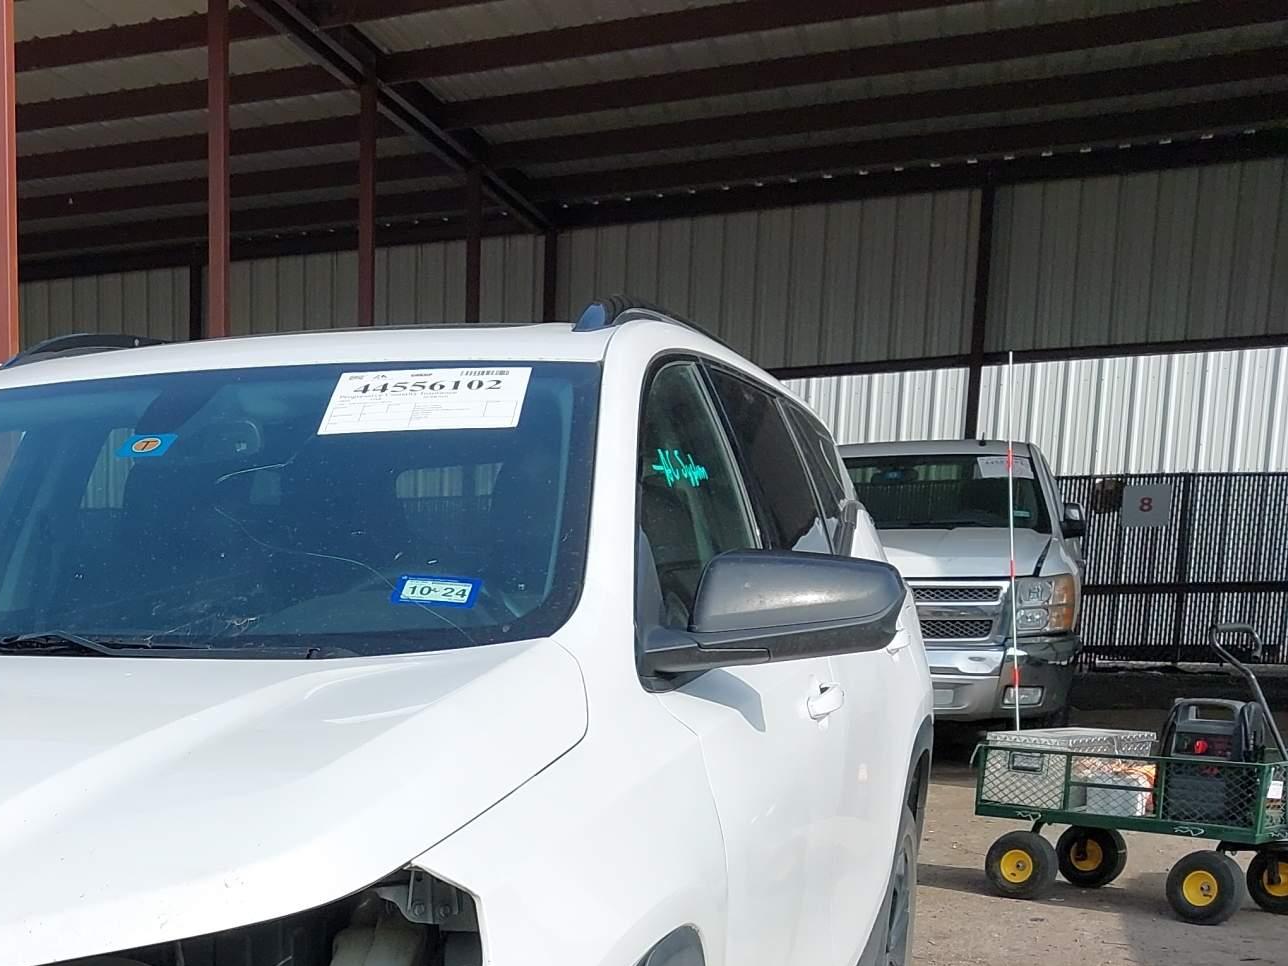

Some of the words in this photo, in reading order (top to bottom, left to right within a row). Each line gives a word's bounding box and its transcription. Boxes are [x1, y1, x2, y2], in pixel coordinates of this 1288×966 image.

[353, 379, 503, 395] 44556102
[1139, 496, 1153, 513] 8
[408, 585, 468, 599] 10-24
